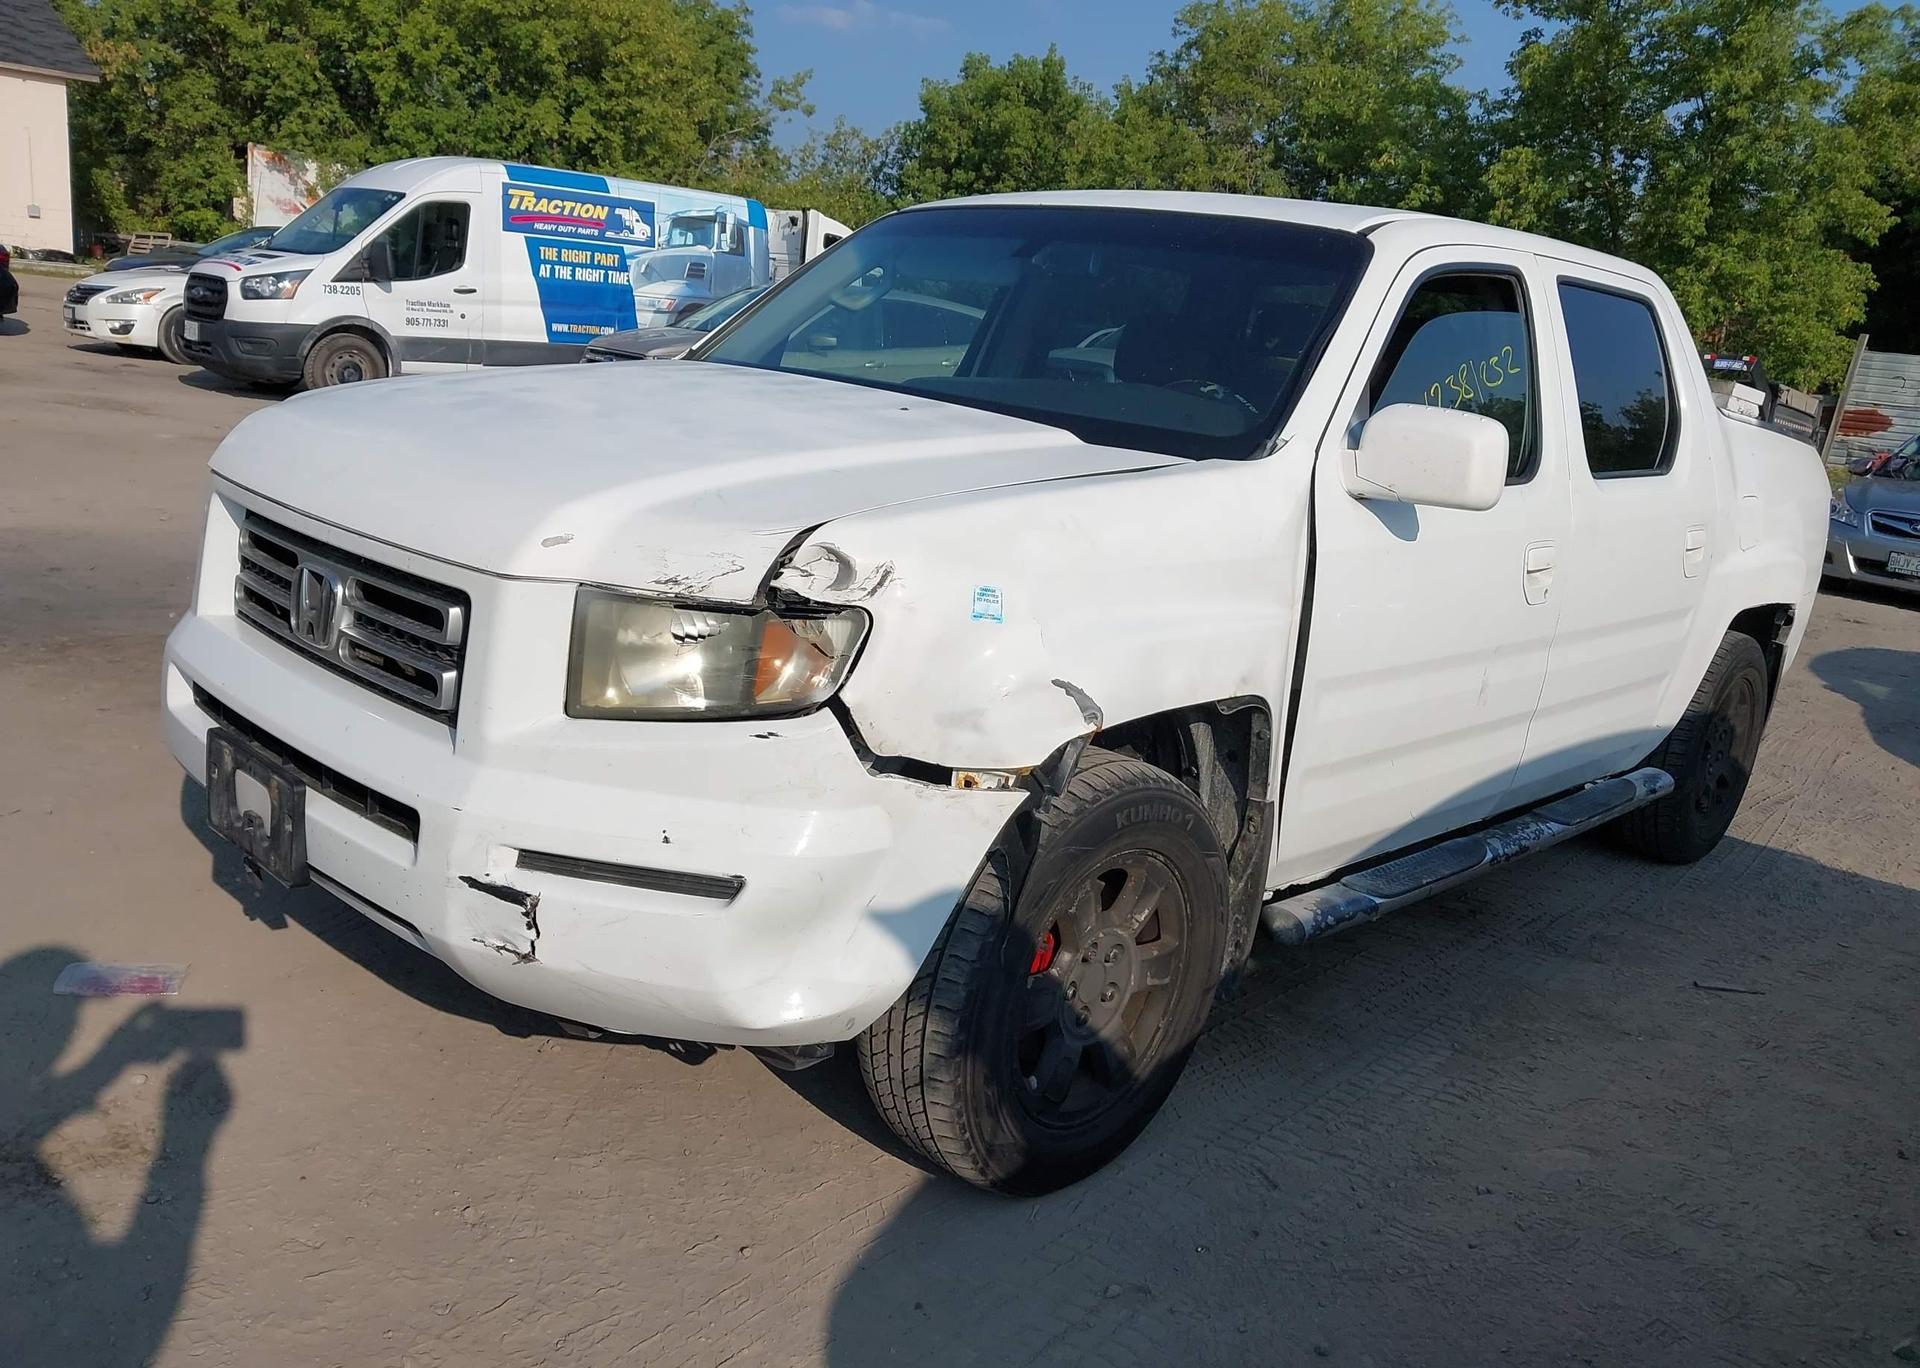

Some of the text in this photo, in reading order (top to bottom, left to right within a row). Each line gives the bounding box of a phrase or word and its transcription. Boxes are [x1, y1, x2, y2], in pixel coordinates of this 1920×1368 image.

[508, 188, 609, 220] TRACTION
[533, 222, 599, 236] HEAVY DUTY PARTS
[539, 246, 619, 267] THE RIGHT PART
[539, 264, 629, 285] AT THE RIGHT TIME
[1115, 804, 1182, 830] KUMHO
